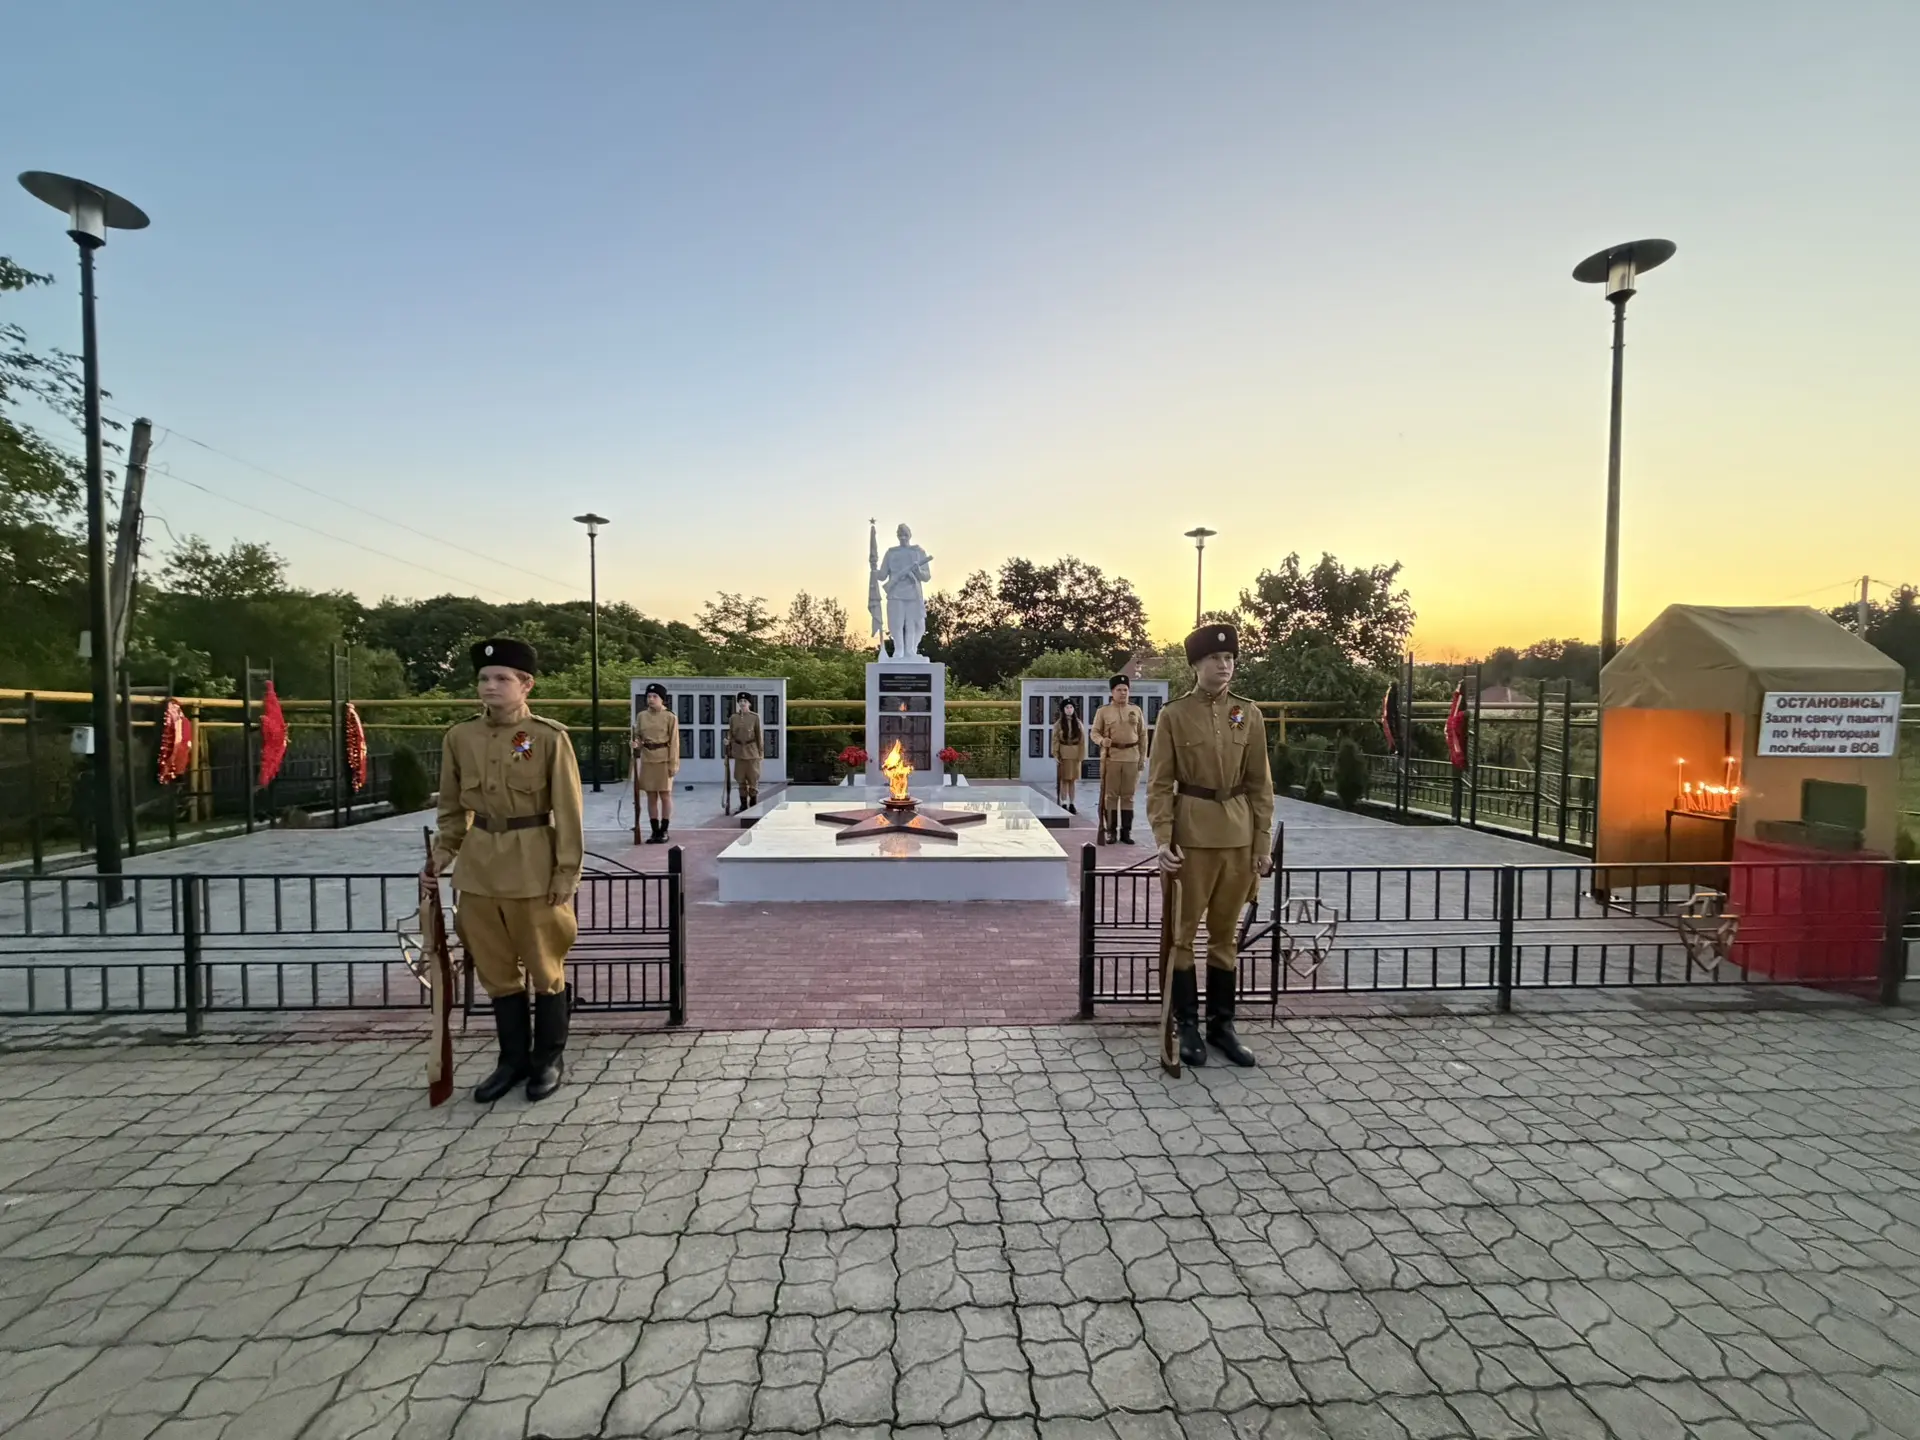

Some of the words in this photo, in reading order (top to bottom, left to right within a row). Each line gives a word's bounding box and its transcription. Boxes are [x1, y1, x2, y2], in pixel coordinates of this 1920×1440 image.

[1776, 697, 1885, 709] ОСТАНОВИСЬ!
[1765, 712, 1802, 724] Зажги
[1806, 714, 1842, 726] свечу
[1847, 714, 1893, 724] памяти
[1772, 730, 1788, 739] по
[1769, 743, 1835, 753] погибшим
[1838, 744, 1847, 753] в
[1851, 742, 1880, 753] ВОВ
